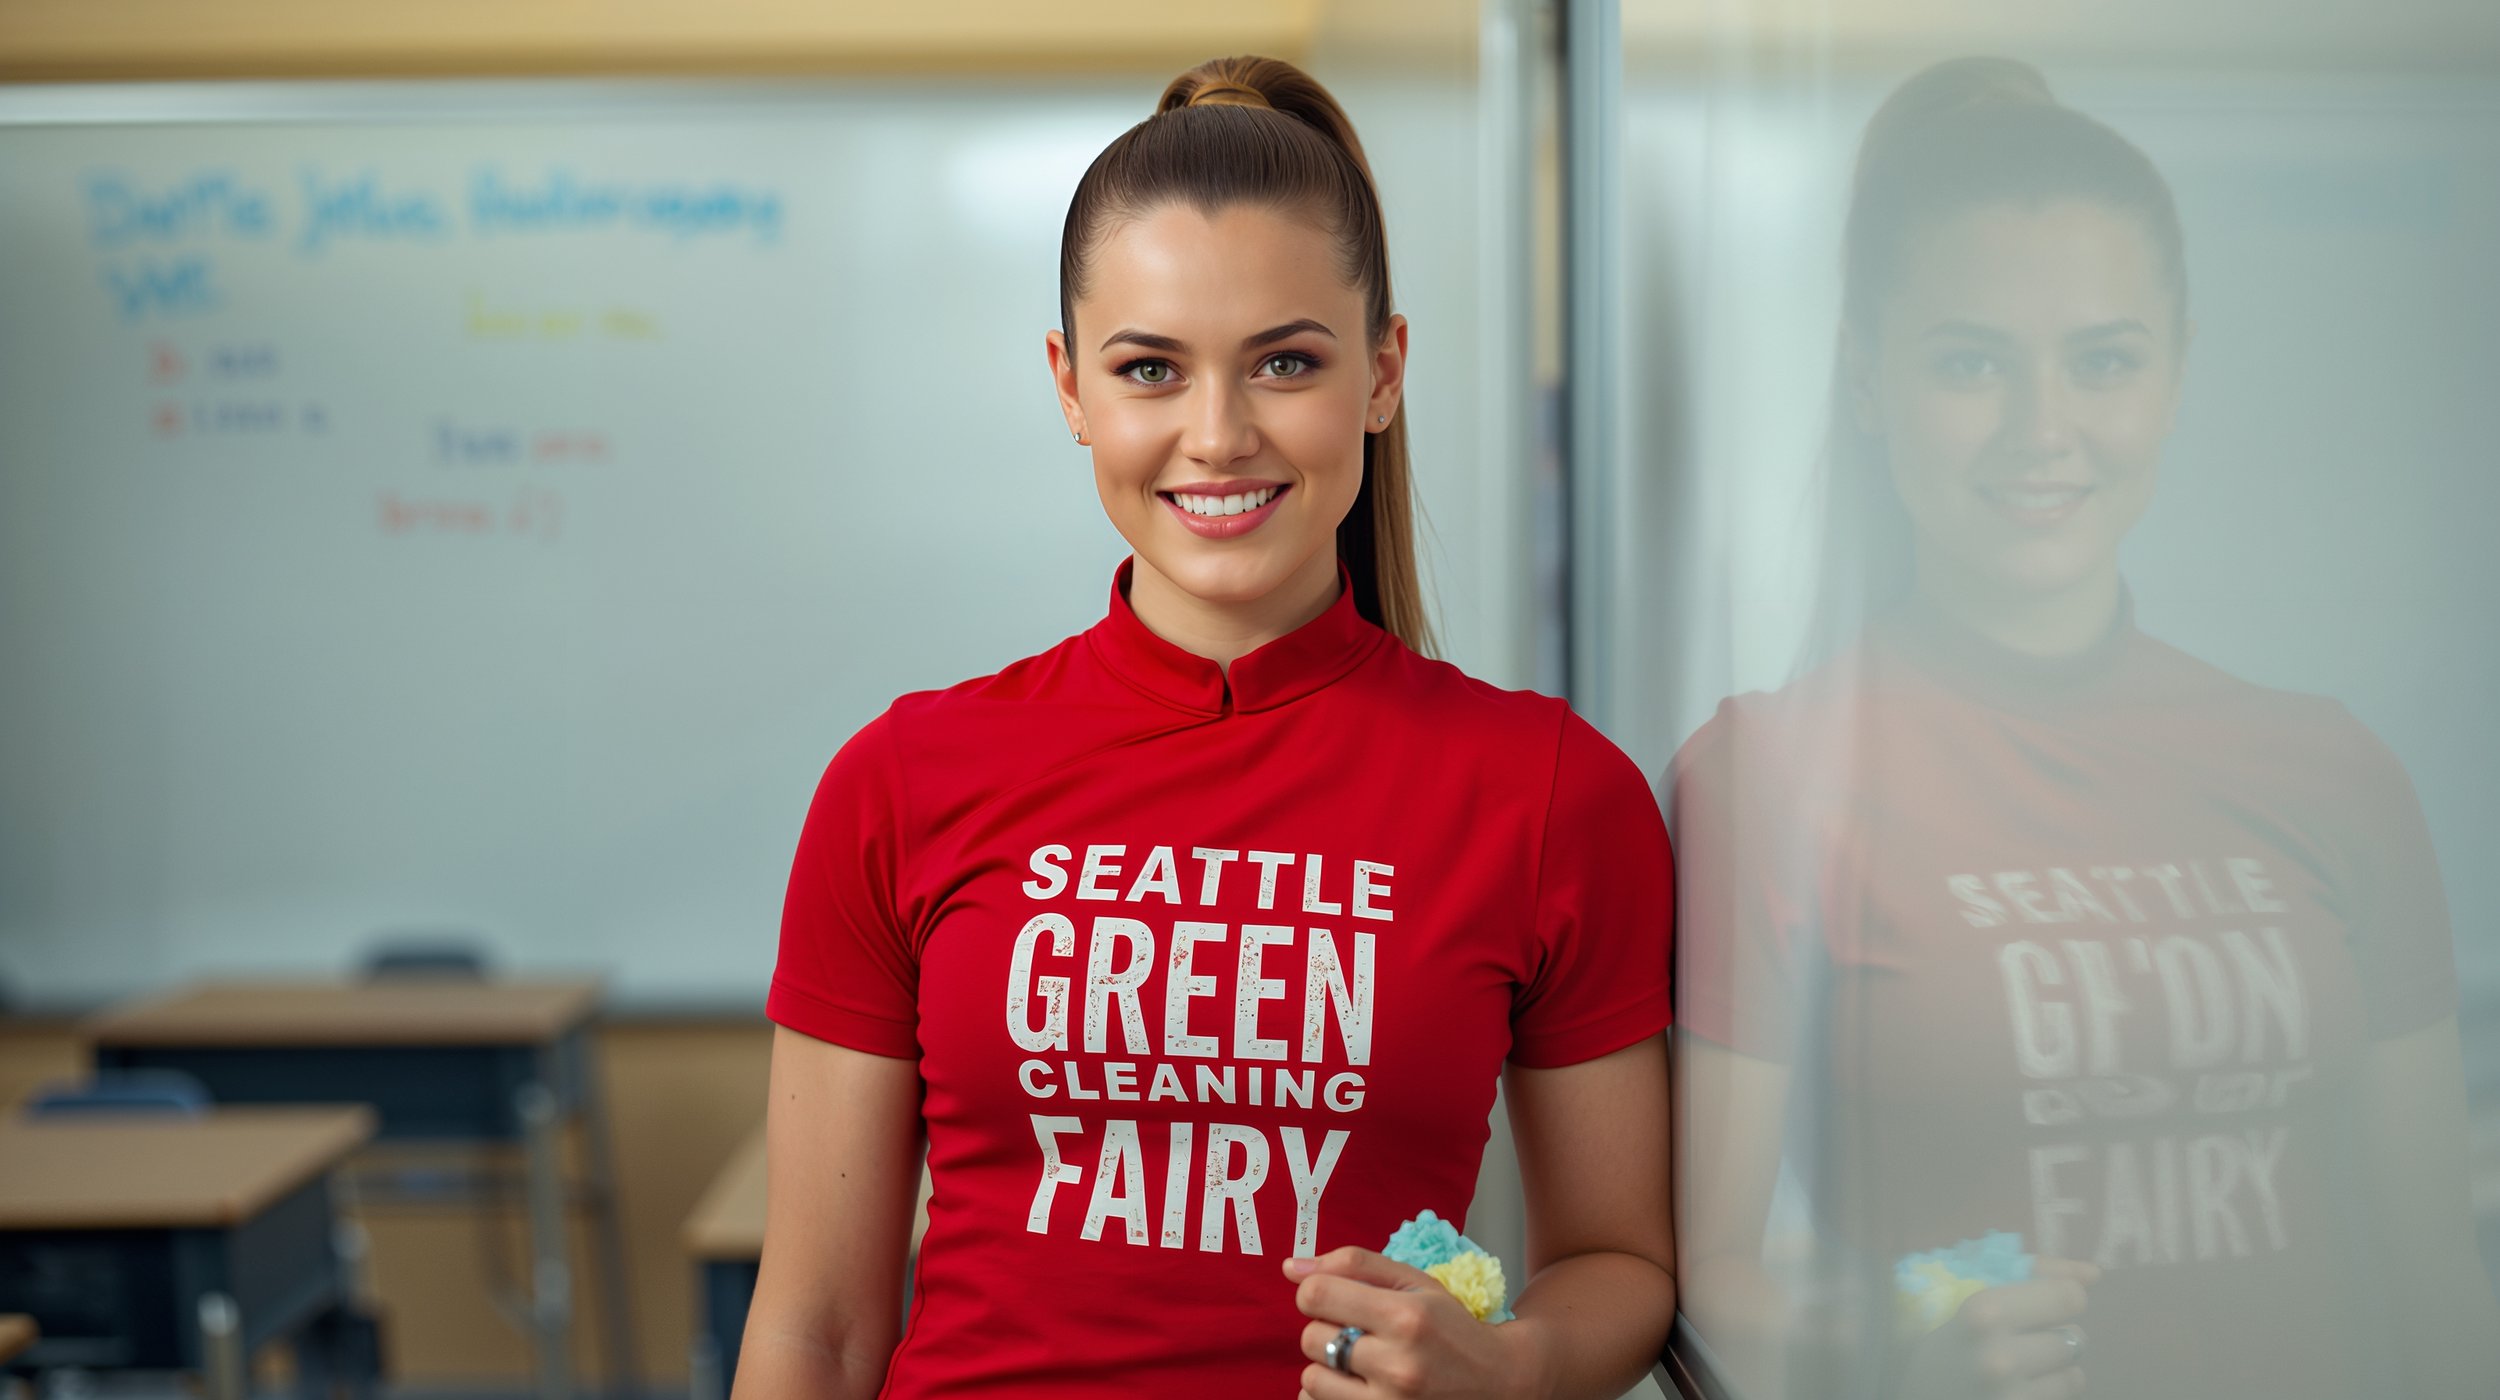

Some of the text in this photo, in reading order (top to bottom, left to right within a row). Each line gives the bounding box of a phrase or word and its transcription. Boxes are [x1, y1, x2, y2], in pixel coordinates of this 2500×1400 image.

[1022, 844, 1395, 921] SEATTLE
[1947, 857, 2290, 928] SEATTLE
[1005, 912, 1376, 1066] GREEN
[1018, 1059, 1366, 1113] CLEANING
[1026, 1113, 1351, 1258] FAIRY
[2027, 1126, 2292, 1270] FAIRY
